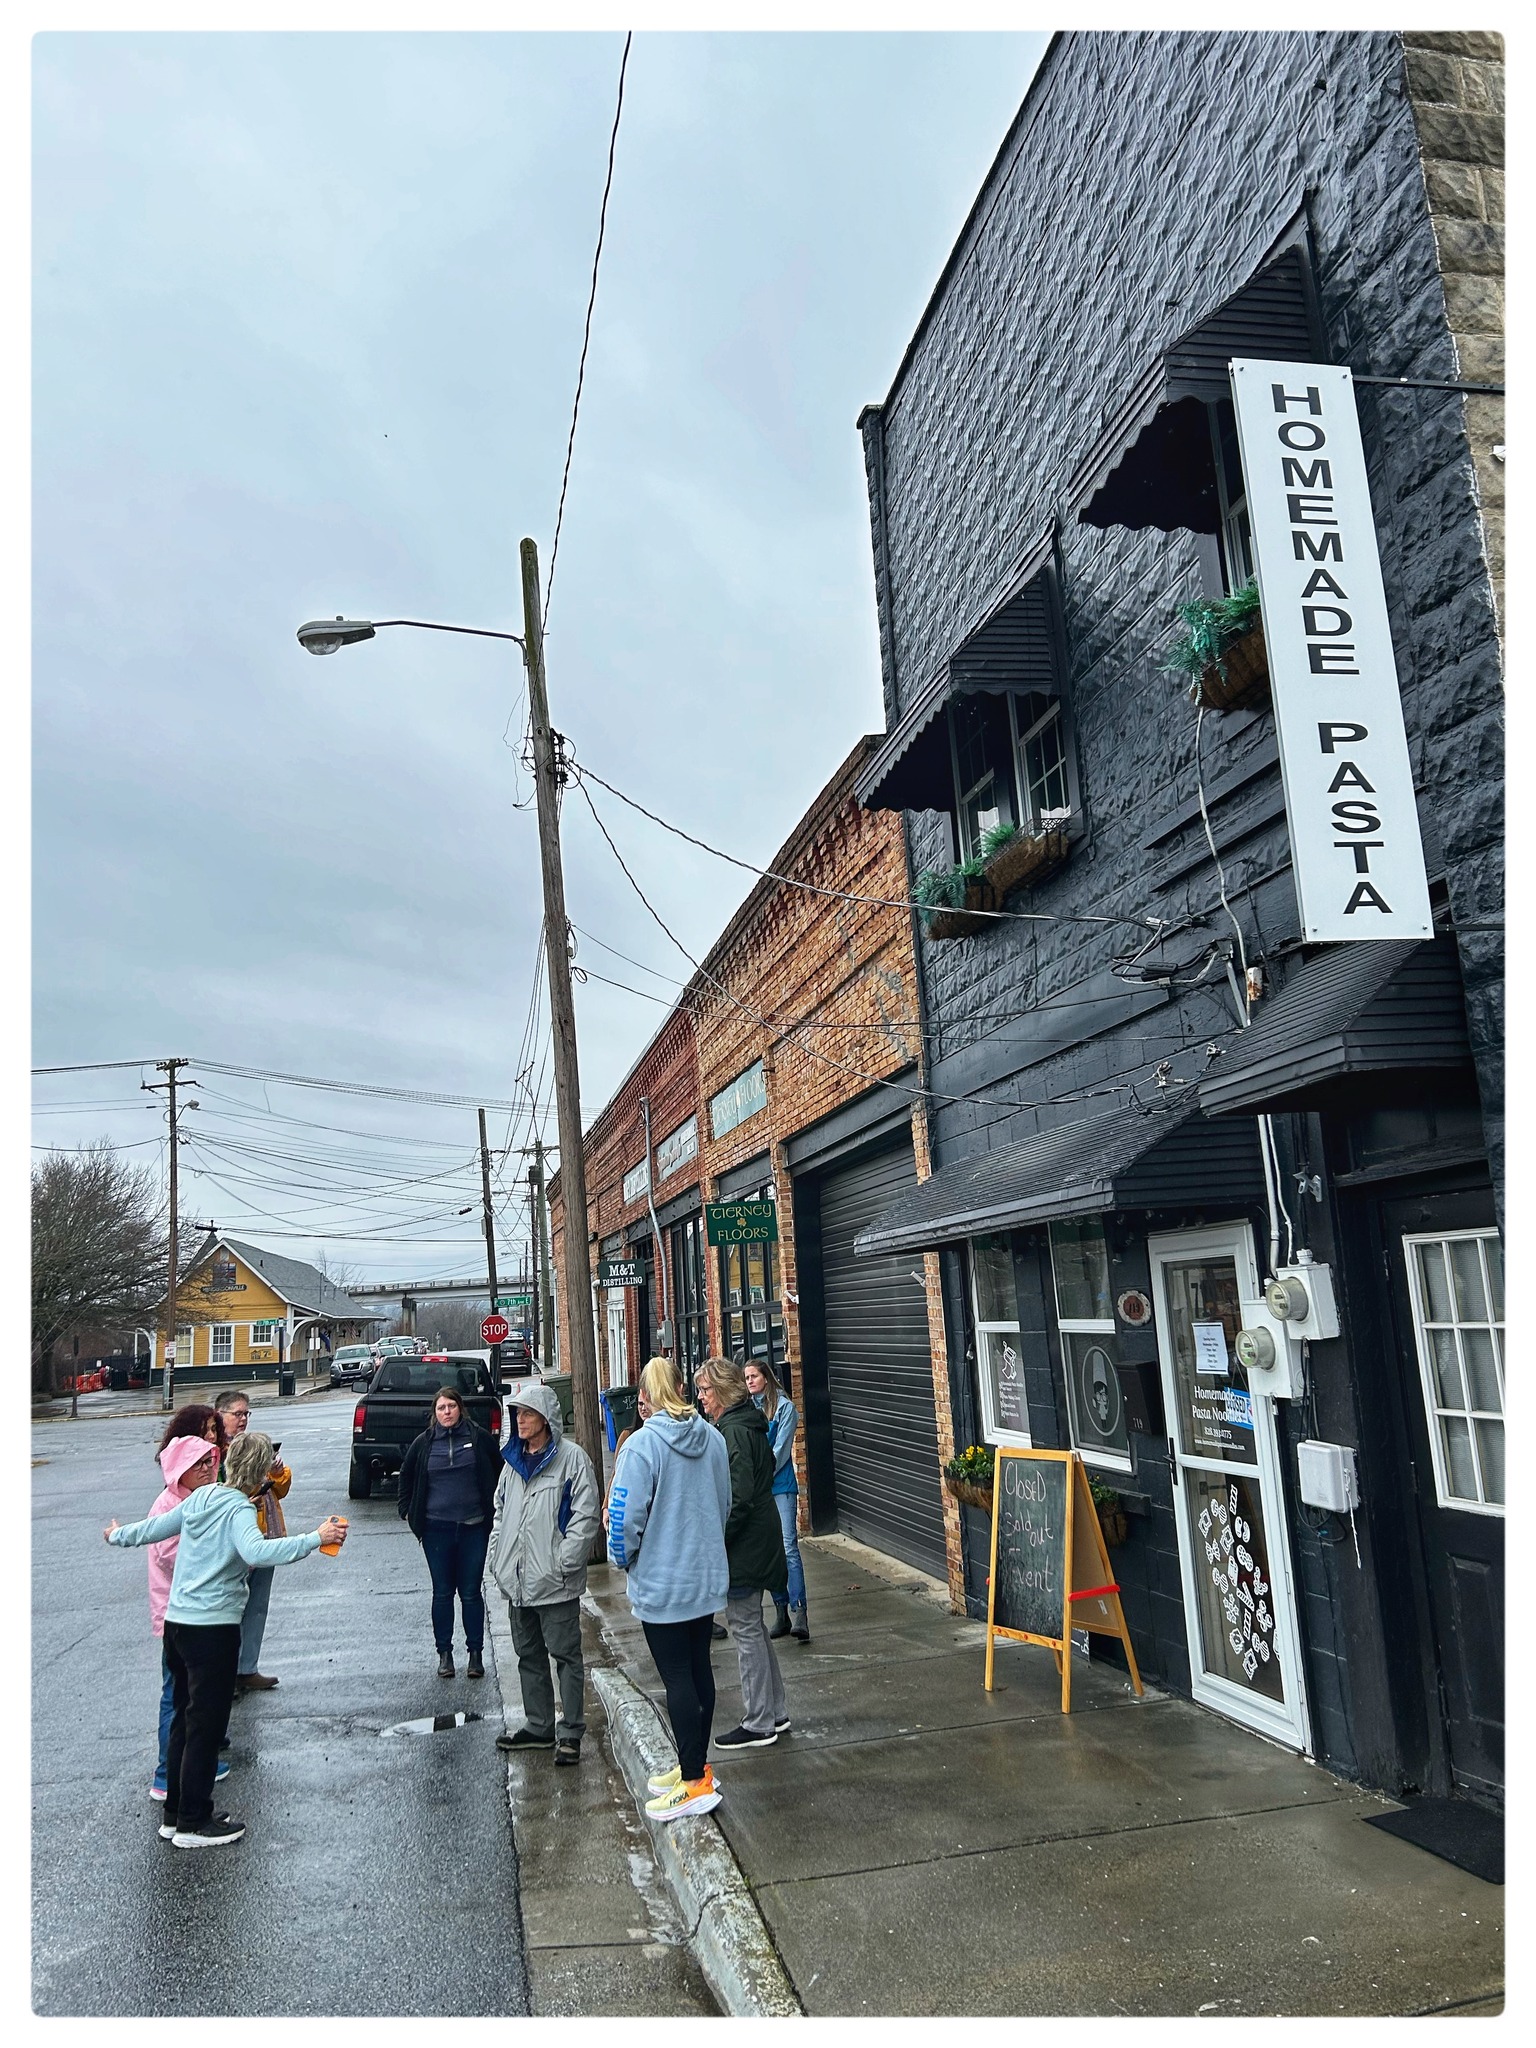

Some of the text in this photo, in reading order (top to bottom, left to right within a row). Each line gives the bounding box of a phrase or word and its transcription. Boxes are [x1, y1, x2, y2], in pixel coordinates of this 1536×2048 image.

[1271, 383, 1394, 915] HOMEMADE PASTA
[710, 1204, 772, 1241] TIERNEY FLOORS
[602, 1263, 643, 1287] M&T DISTILLING
[482, 1323, 507, 1336] STOP
[1194, 1385, 1235, 1401] Homemade
[1192, 1405, 1211, 1419] Pasta
[1212, 1407, 1243, 1423] Noodles
[1030, 1512, 1054, 1547] out
[669, 1791, 690, 1807] HOKA
